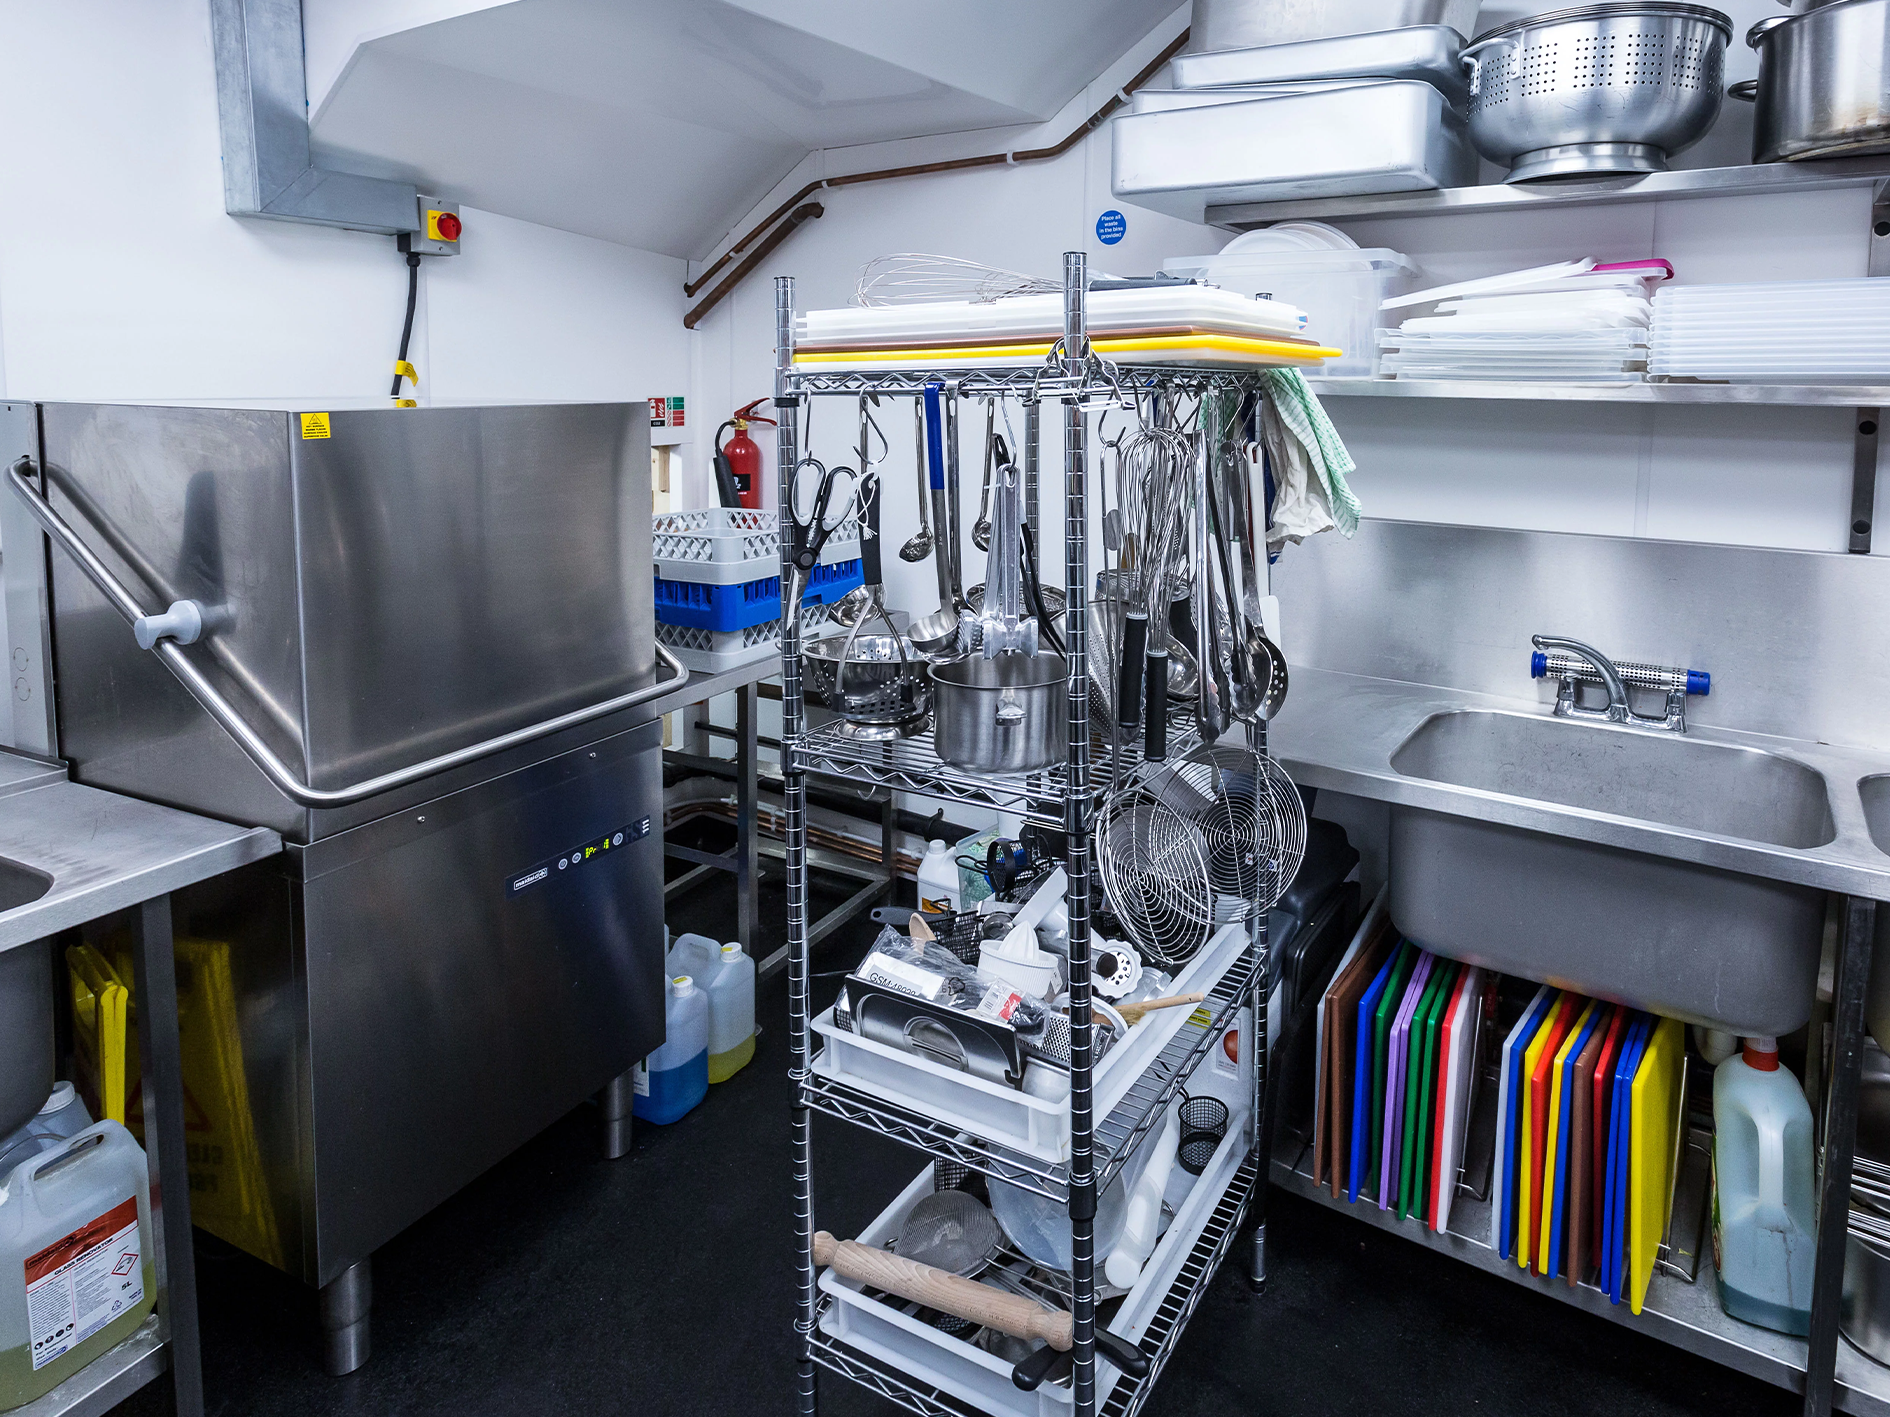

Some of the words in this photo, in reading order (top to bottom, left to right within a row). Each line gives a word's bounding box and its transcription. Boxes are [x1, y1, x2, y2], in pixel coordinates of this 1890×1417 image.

[1101, 232, 1122, 240] provided
[54, 1260, 75, 1275] GLASS
[76, 1238, 113, 1263] RENOVATOR
[121, 1281, 133, 1291] 5L
